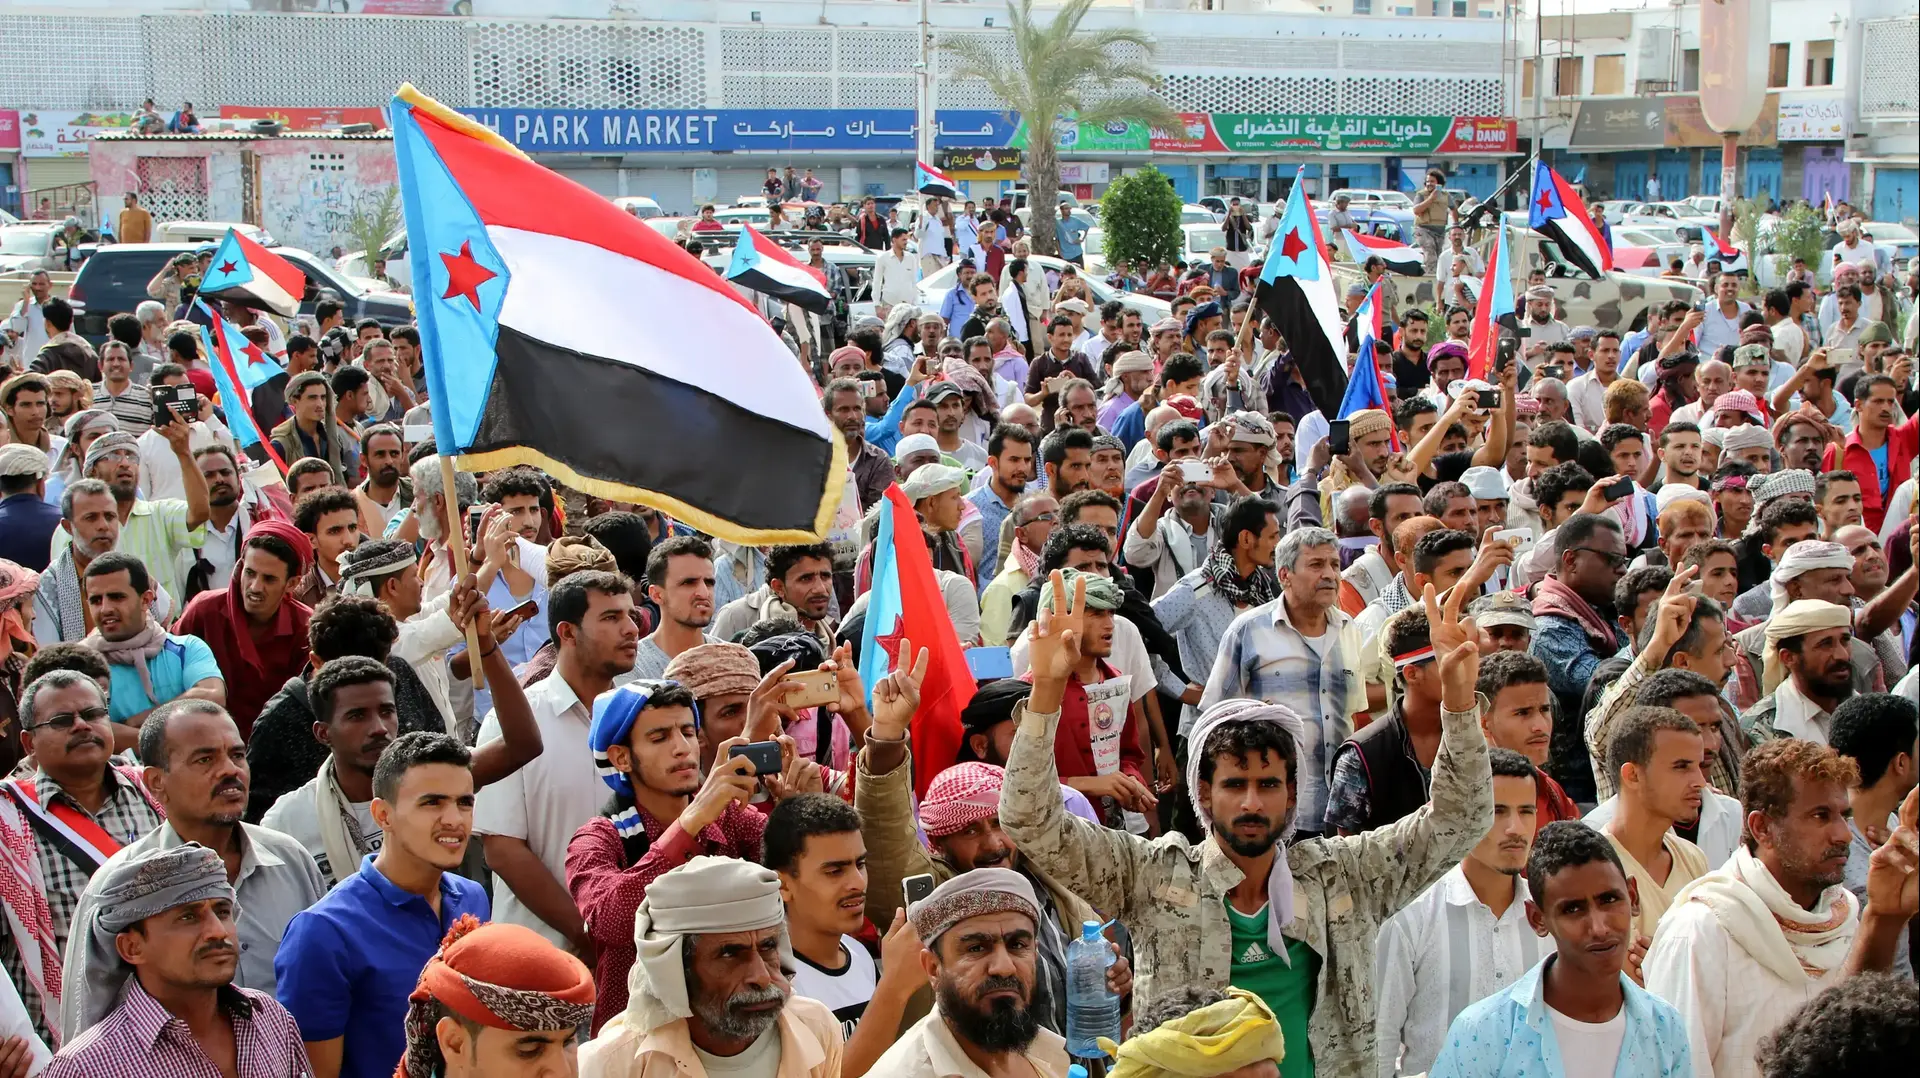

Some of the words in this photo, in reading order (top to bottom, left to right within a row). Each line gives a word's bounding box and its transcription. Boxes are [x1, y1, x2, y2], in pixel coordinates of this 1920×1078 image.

[515, 115, 590, 145] PARK
[603, 115, 718, 146] MARKET
[733, 120, 836, 138] ماركت
[845, 120, 914, 138] بارك
[1233, 118, 1299, 139] الخضراء
[1372, 119, 1432, 141] حلويات
[1476, 130, 1506, 142] DANO
[951, 153, 975, 166] كريم
[1240, 953, 1270, 964] adidas
